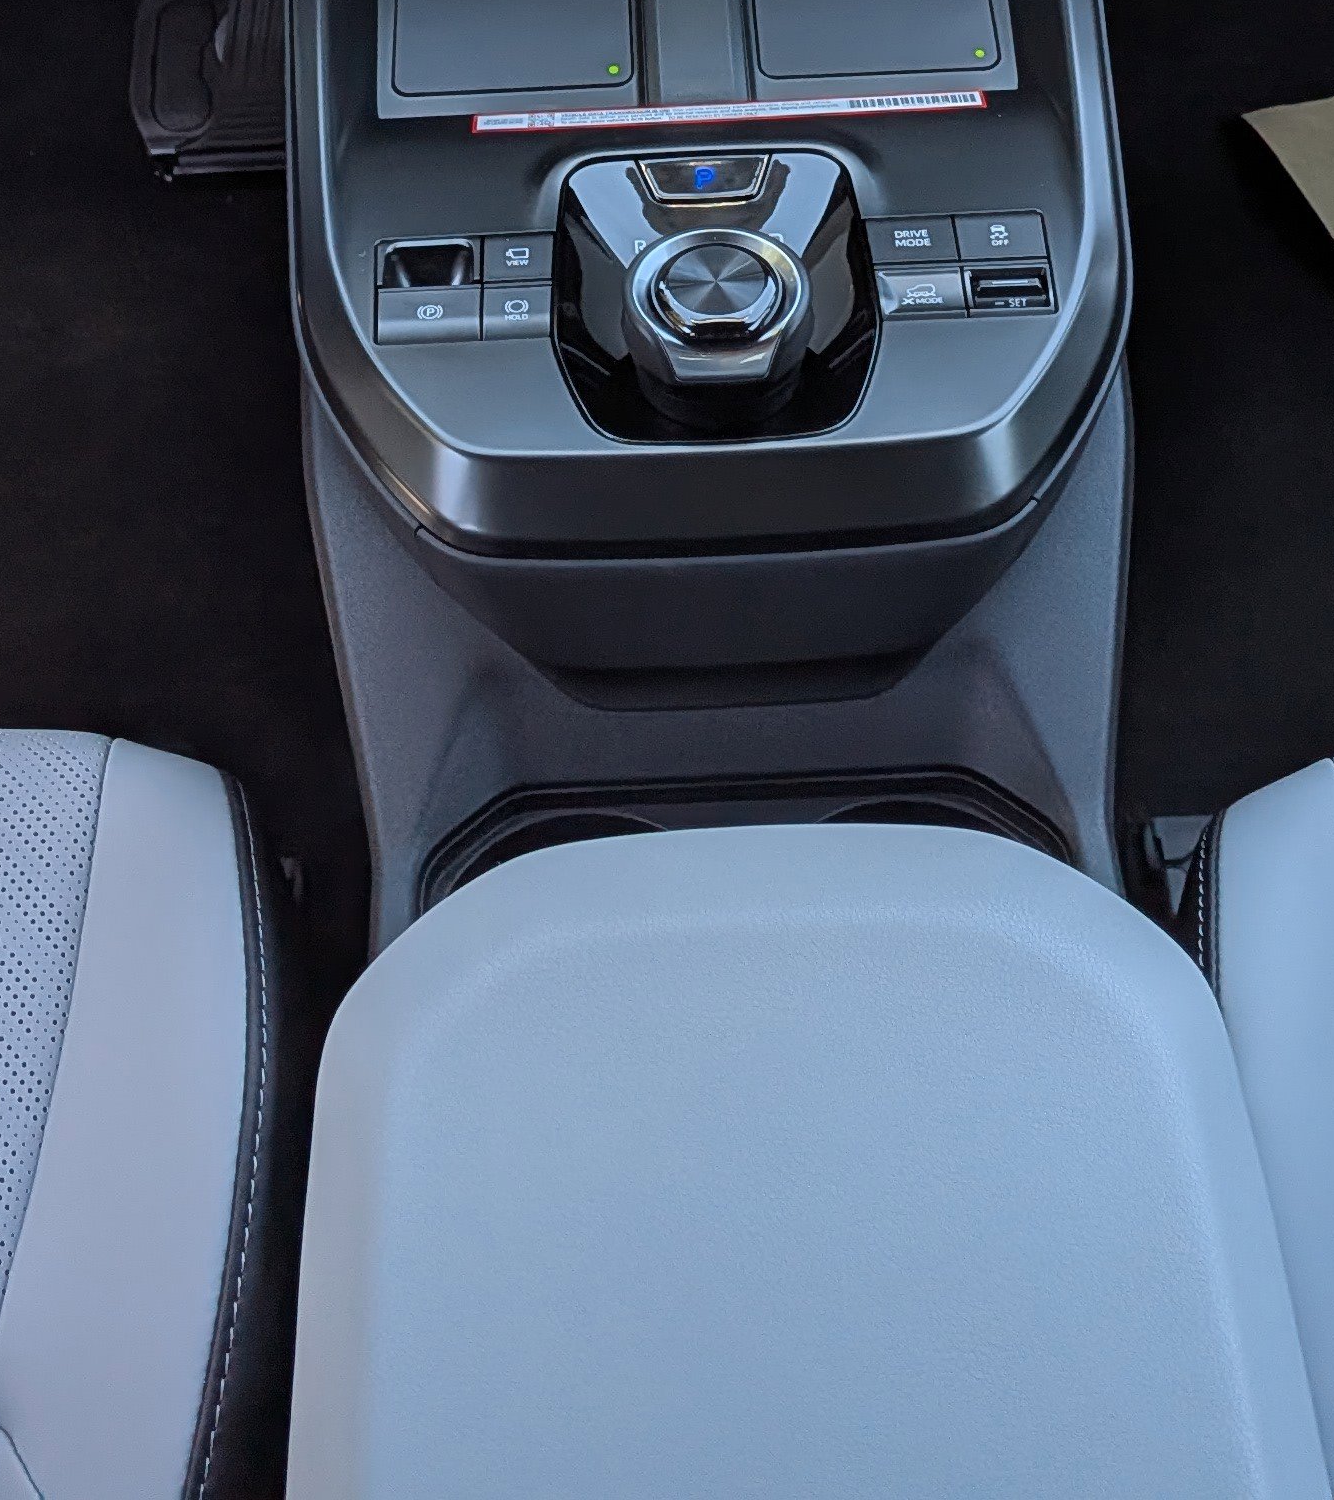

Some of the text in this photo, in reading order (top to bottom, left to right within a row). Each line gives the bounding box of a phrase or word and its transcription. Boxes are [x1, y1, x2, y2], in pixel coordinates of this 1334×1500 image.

[694, 167, 714, 190] P
[894, 229, 928, 239] DRIVE
[895, 237, 932, 248] MODE
[505, 259, 529, 267] VIEW
[916, 296, 944, 304] MODE
[1008, 297, 1027, 308] SET
[504, 313, 529, 321] HOLD
